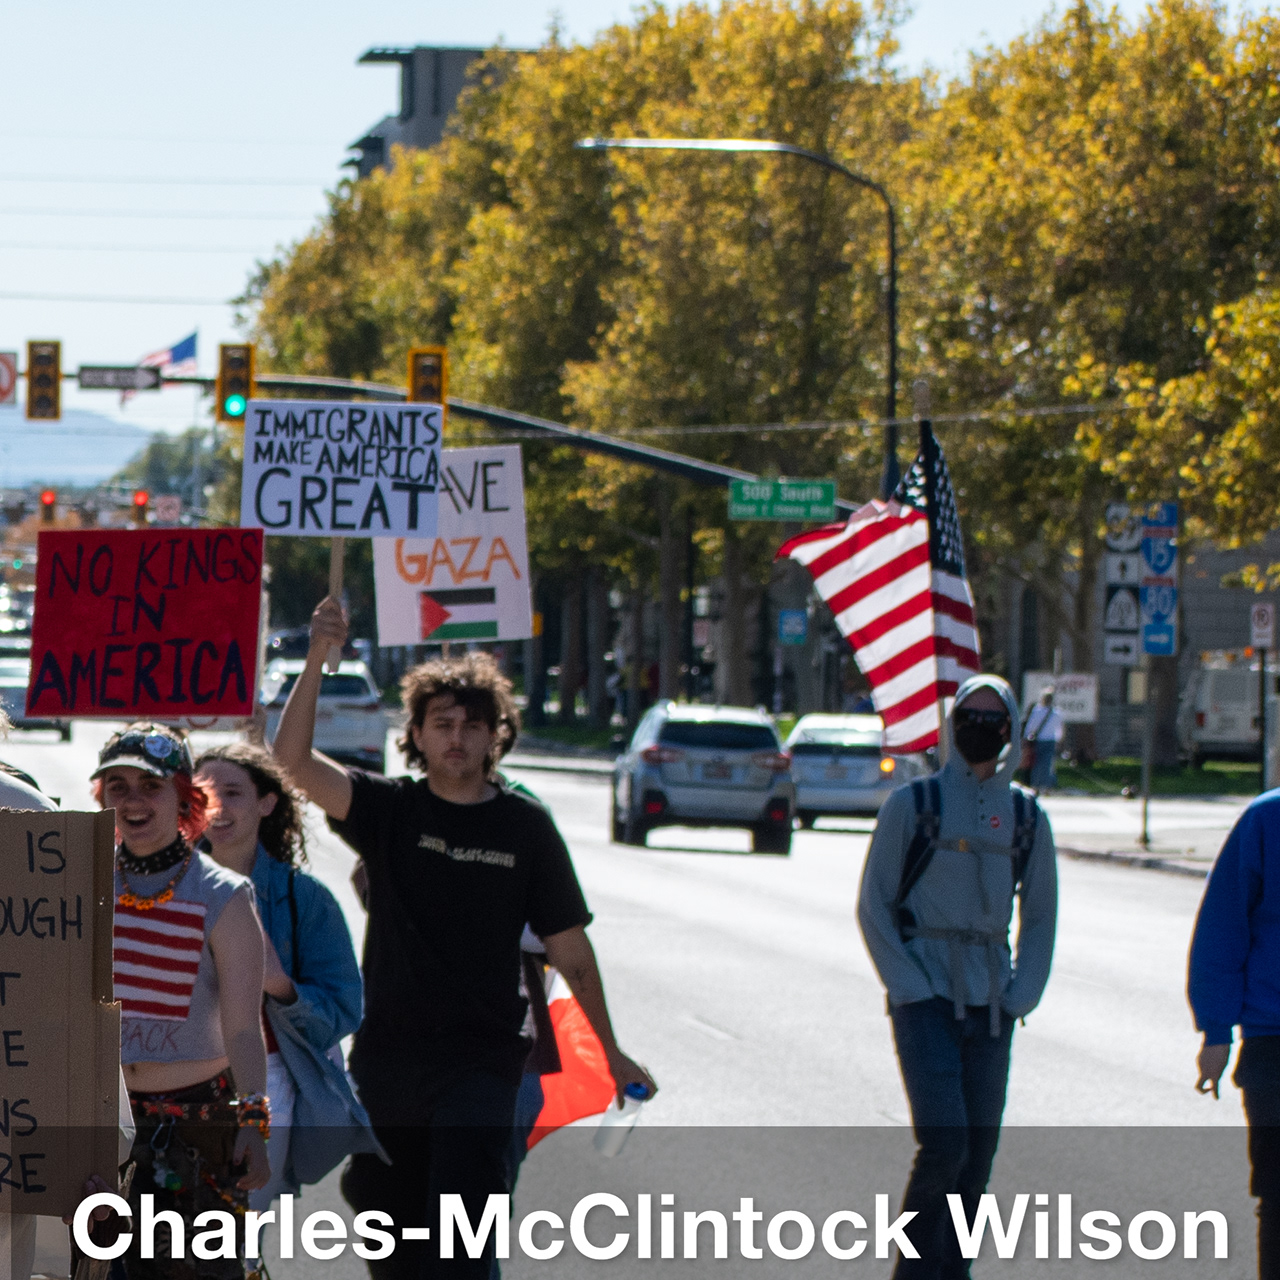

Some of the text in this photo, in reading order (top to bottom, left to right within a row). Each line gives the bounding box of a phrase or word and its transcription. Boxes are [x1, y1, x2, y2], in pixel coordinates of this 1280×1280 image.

[254, 408, 439, 447] IMMIGRANTS
[253, 440, 439, 484] MAKE AMERICA
[254, 467, 436, 531] GREAT
[48, 532, 259, 598] NO KINGS
[395, 537, 521, 585] GAZA
[107, 592, 166, 636] IN
[29, 638, 247, 710] AMERICA
[27, 829, 66, 874] IS
